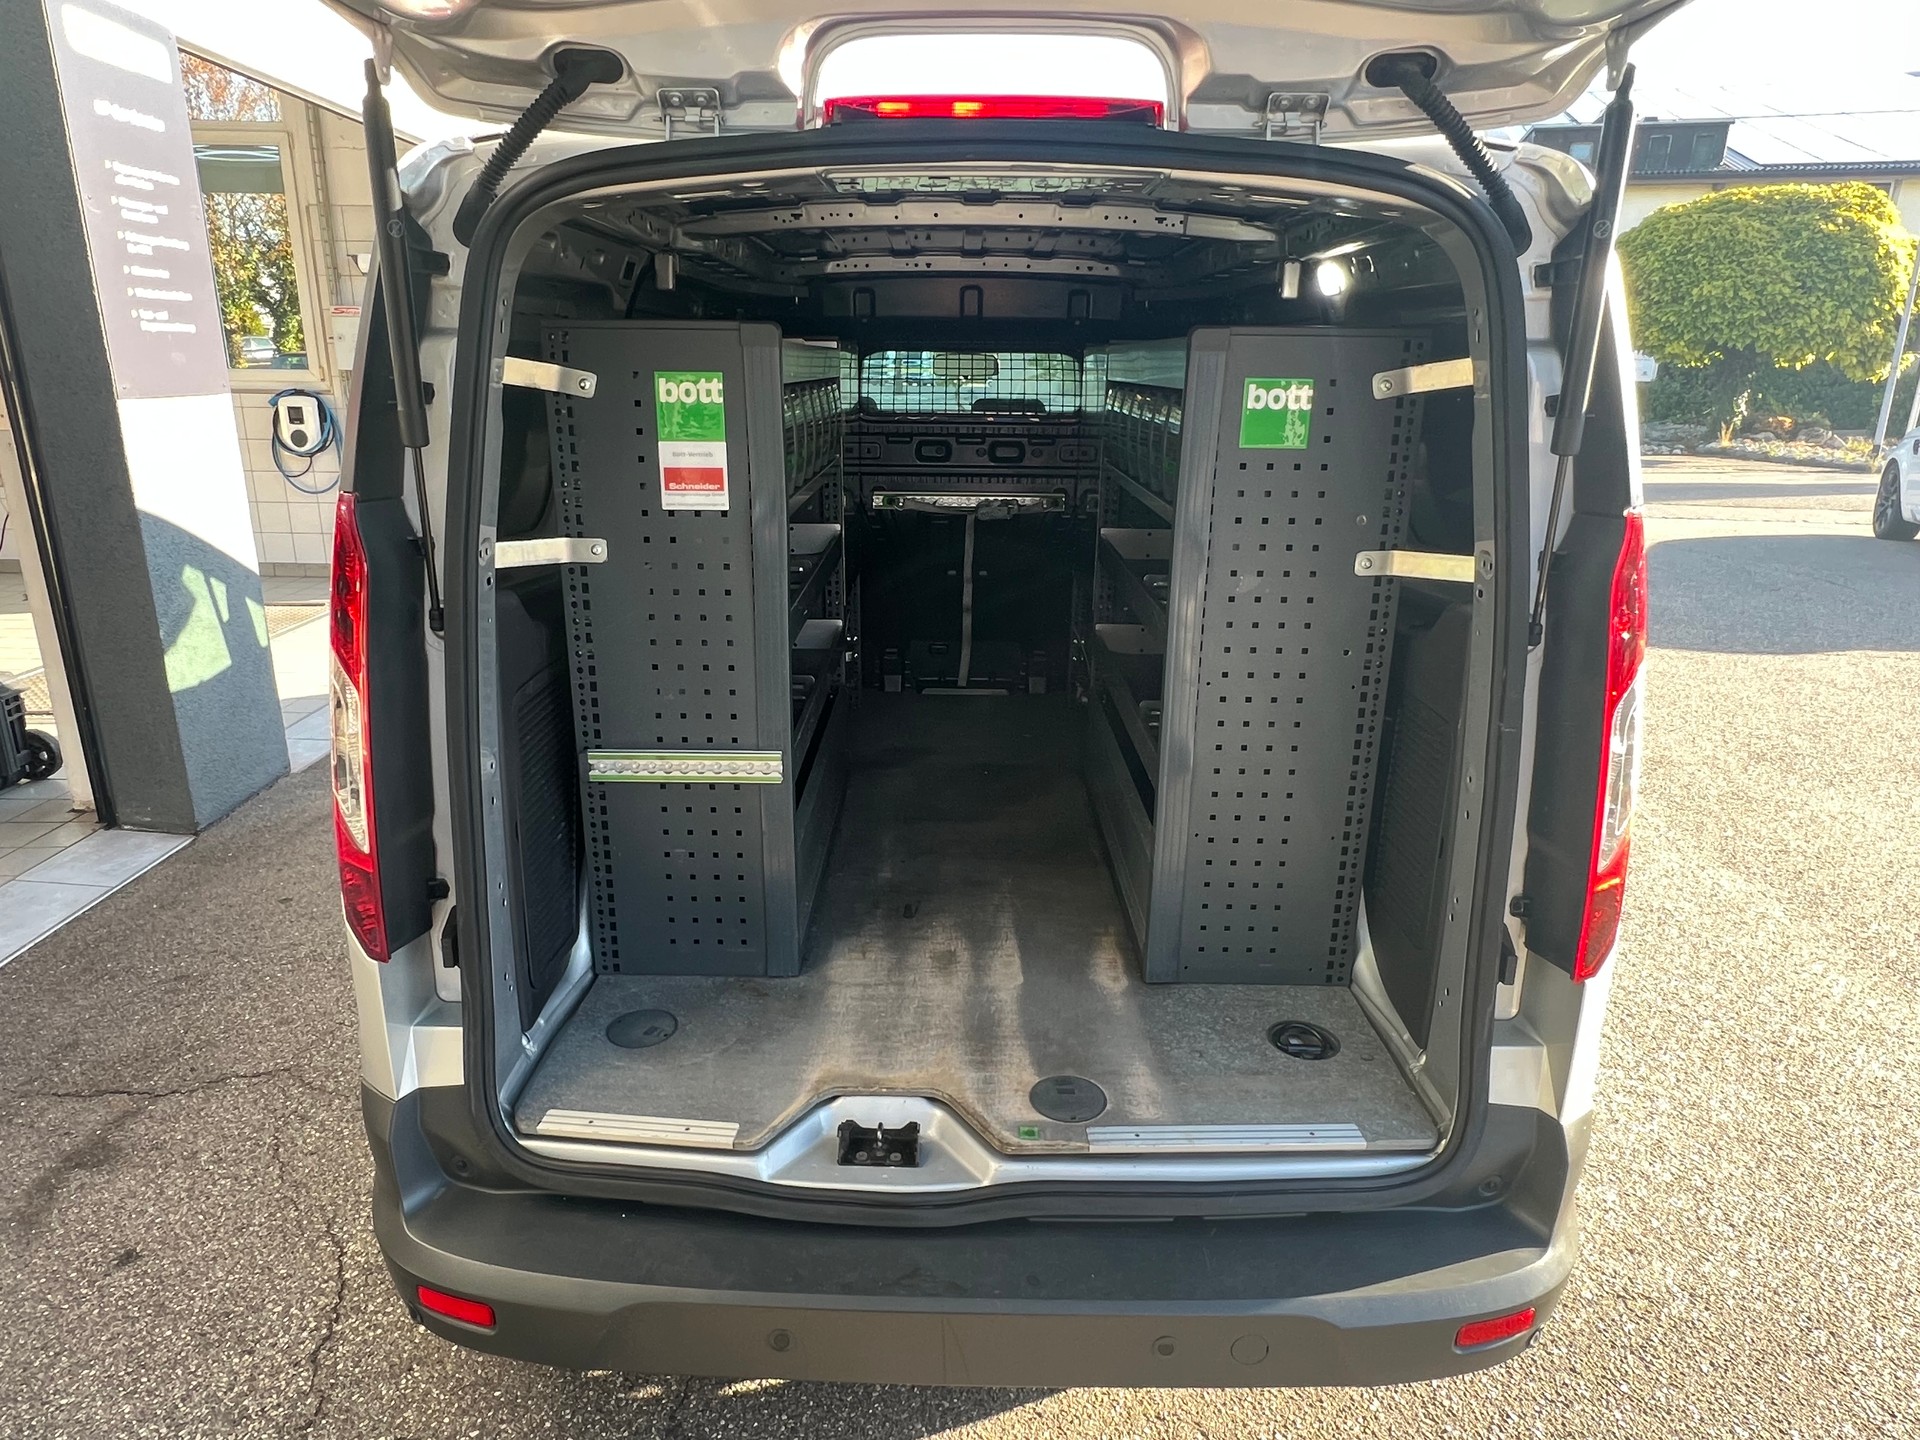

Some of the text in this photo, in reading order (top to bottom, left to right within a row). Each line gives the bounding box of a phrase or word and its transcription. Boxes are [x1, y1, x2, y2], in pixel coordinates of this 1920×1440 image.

[658, 377, 724, 404] bott
[1246, 383, 1314, 411] bott
[668, 482, 721, 490] Schneider
